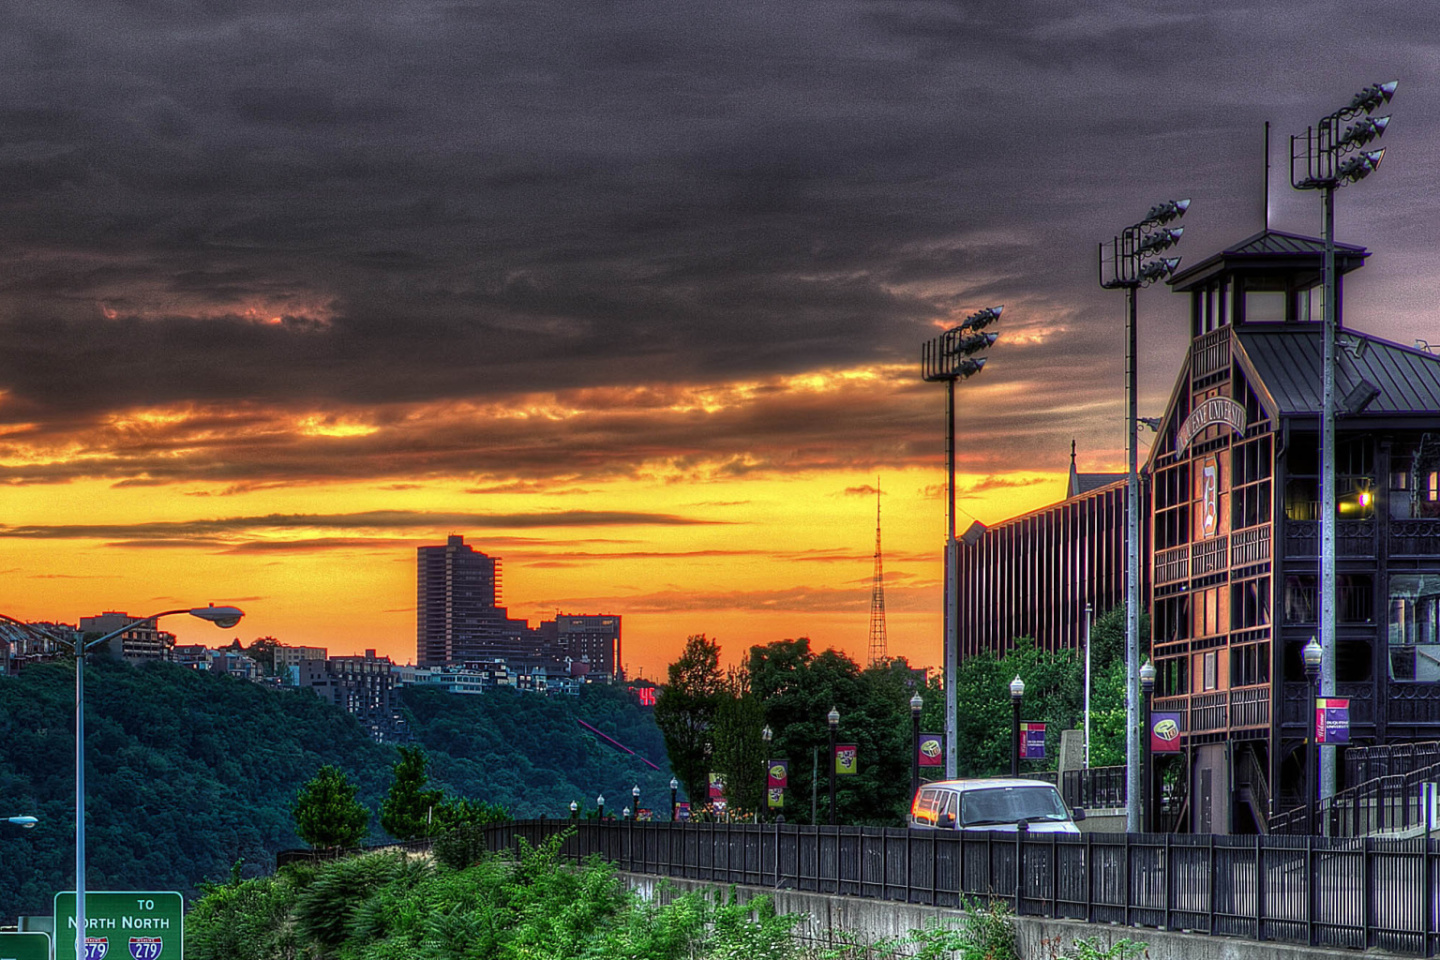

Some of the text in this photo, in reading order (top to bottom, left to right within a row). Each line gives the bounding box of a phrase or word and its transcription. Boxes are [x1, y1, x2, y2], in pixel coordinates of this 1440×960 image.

[1208, 400, 1245, 432] UNIVERSITY
[137, 899, 155, 911] TO
[122, 915, 170, 929] NORTH
[135, 943, 157, 958] 279
